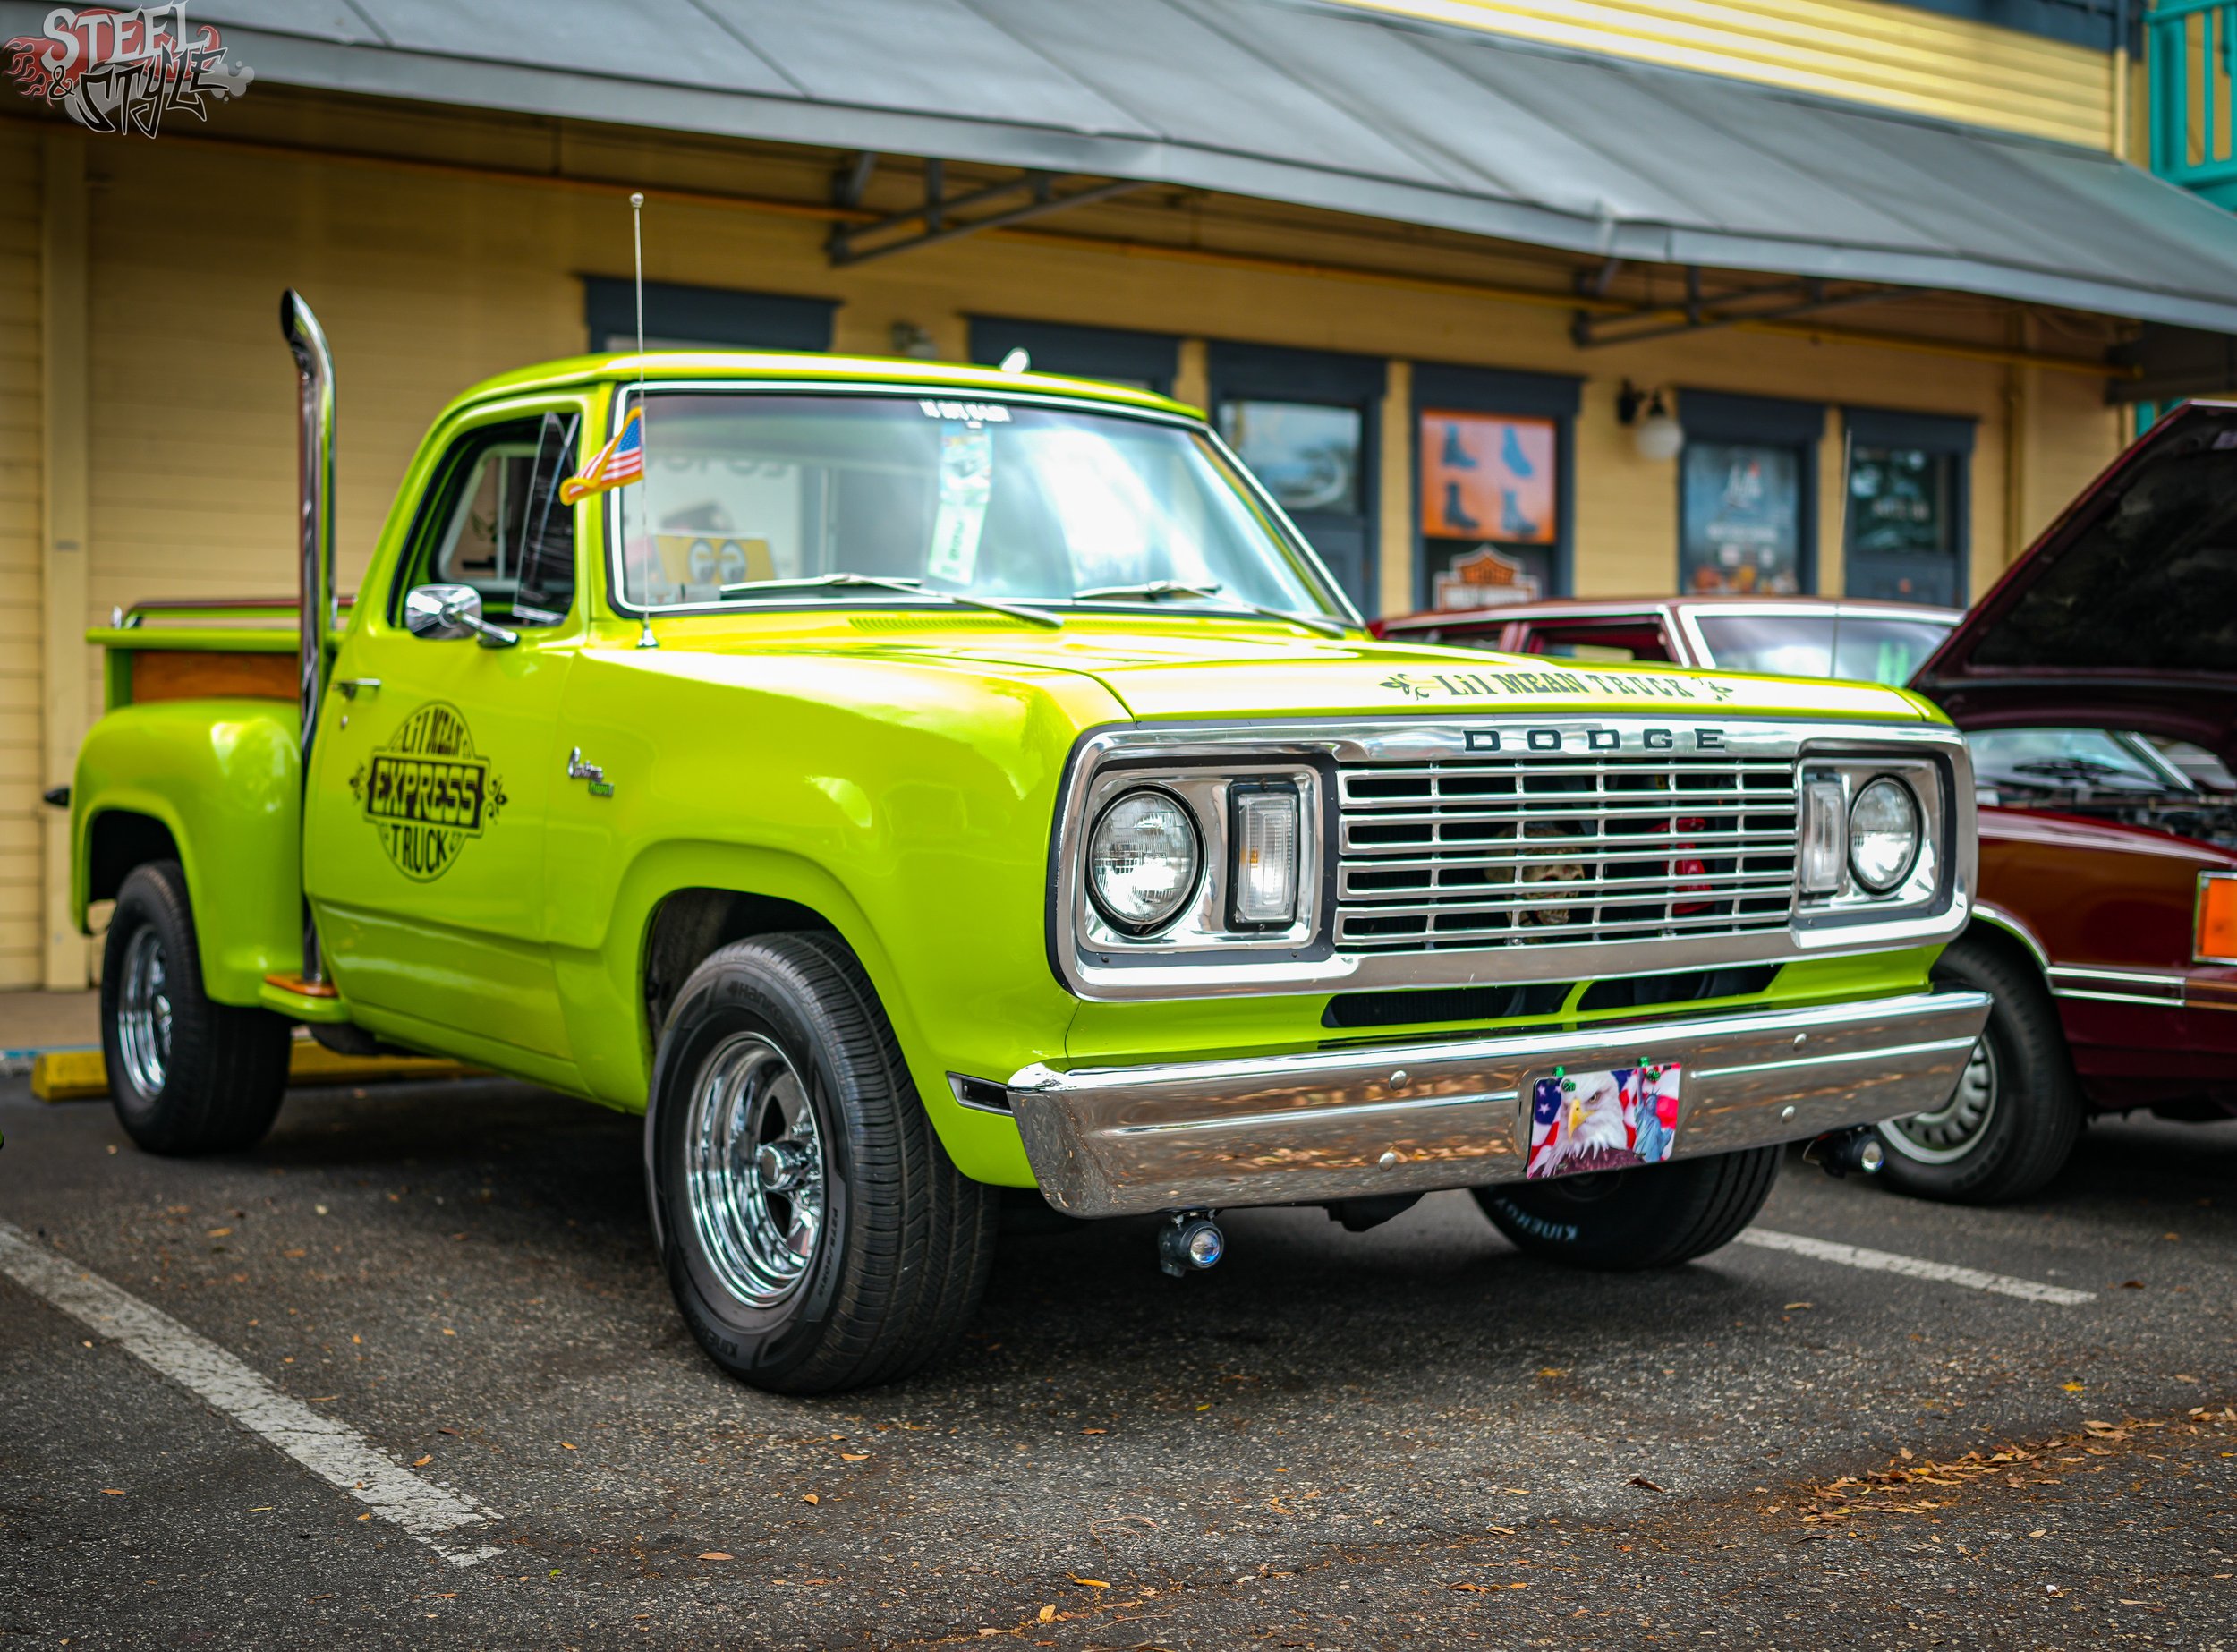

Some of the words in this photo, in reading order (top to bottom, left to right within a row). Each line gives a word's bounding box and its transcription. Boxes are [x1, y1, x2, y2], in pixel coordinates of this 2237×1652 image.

[1495, 672, 1588, 694] MEAN
[1589, 674, 1696, 698] TRUCK
[1462, 728, 1727, 752] DODGE
[371, 760, 479, 826] EXPRESS
[391, 823, 449, 873] TRUCK
